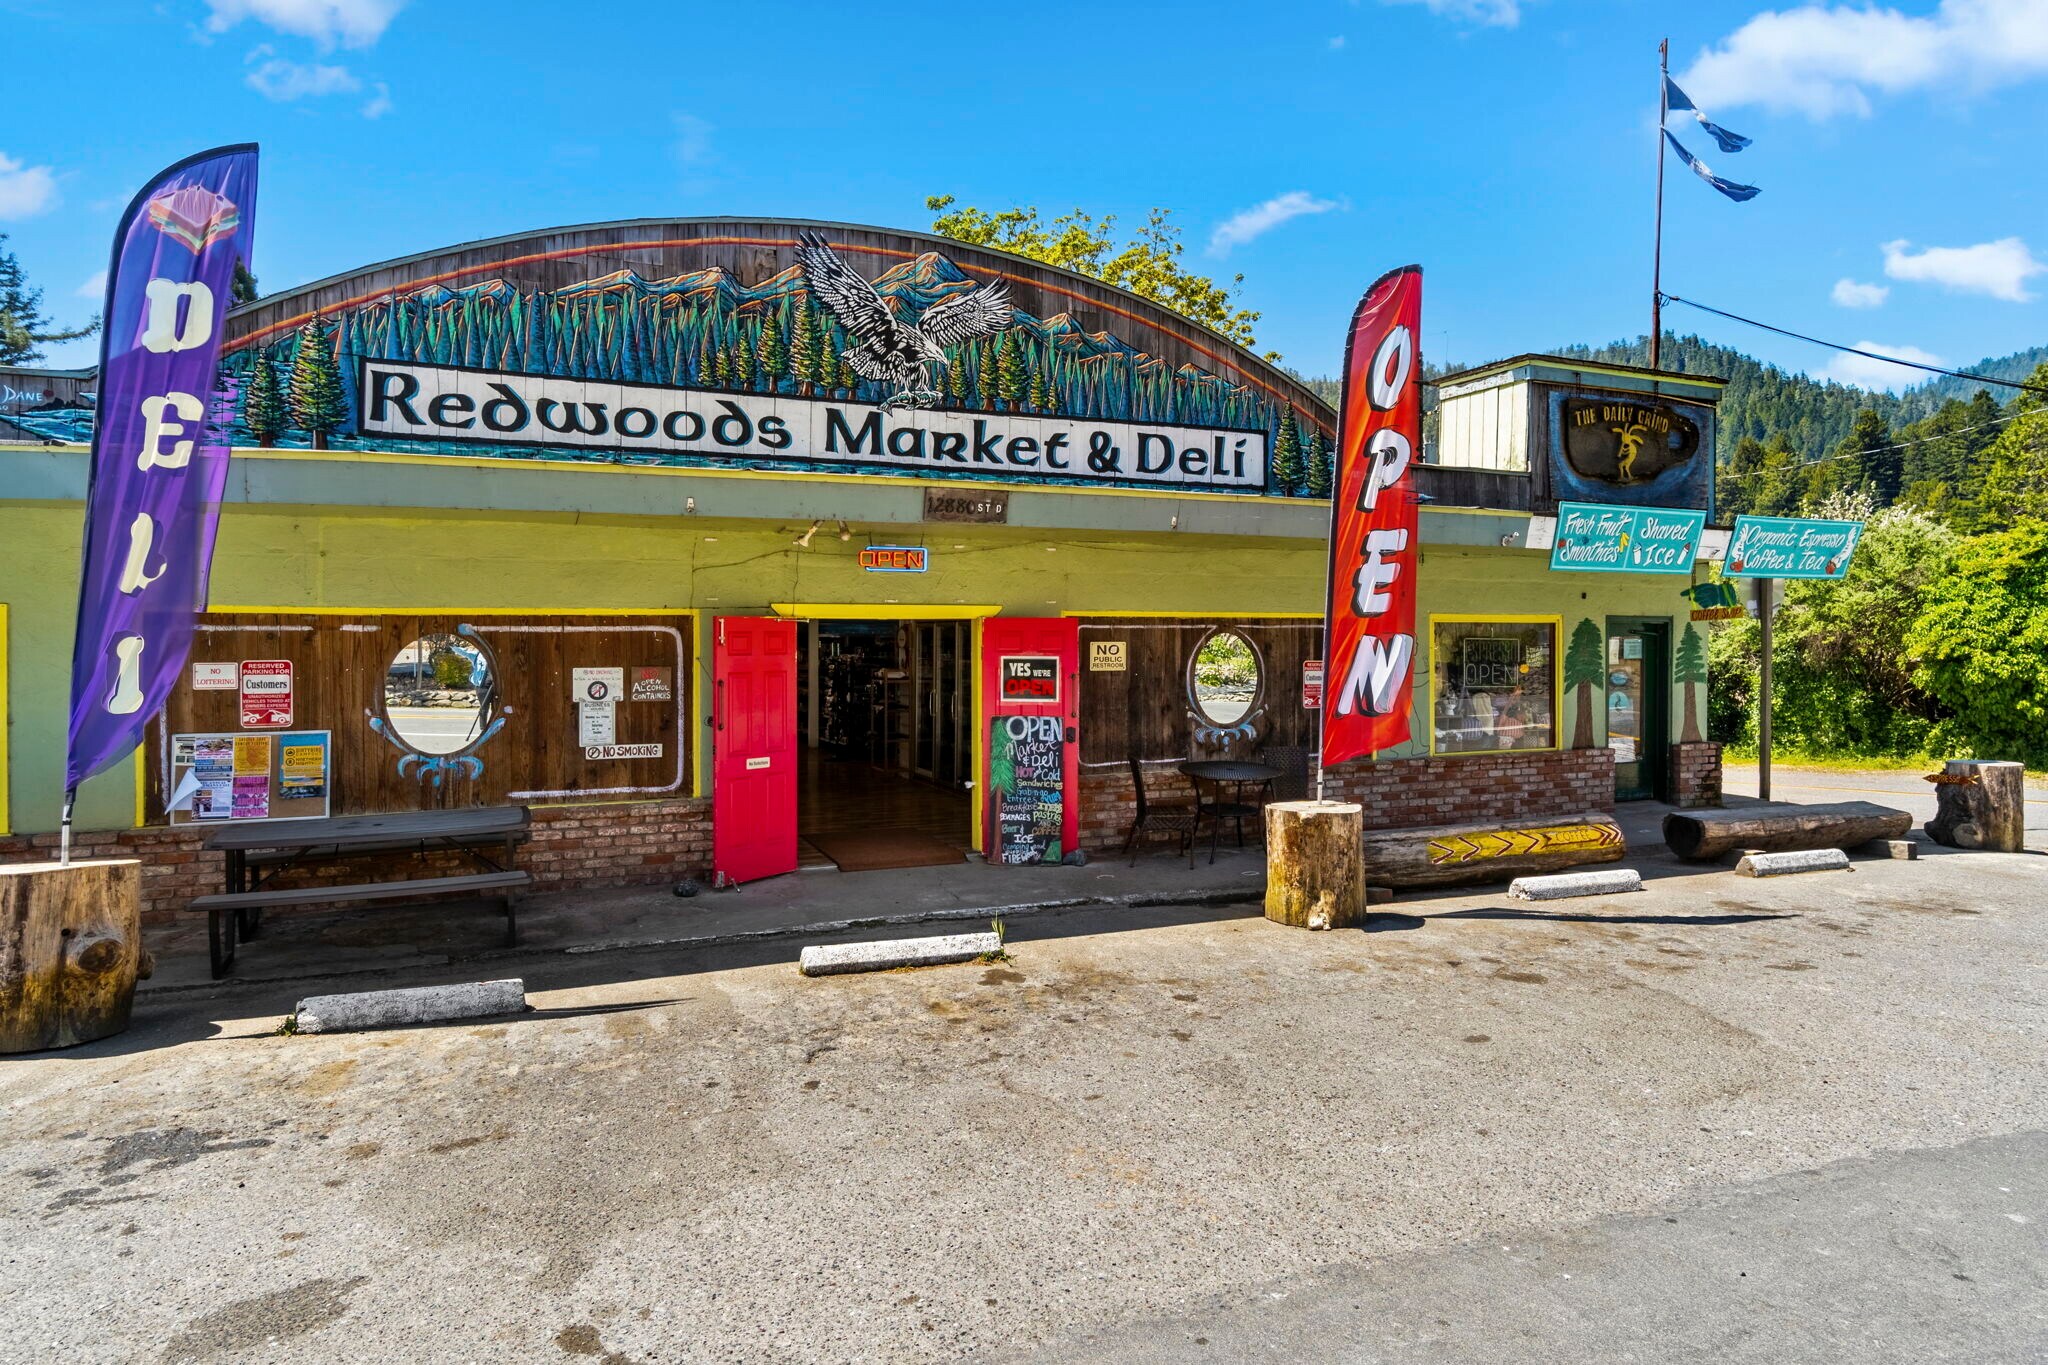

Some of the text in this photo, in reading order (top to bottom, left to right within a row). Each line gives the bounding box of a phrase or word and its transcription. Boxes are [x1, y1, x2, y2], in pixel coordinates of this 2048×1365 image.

[370, 369, 1247, 478] Redwoods Market & Deli
[1575, 403, 1669, 433] THE DAILY GRIND
[116, 277, 212, 716] DELI
[1333, 323, 1415, 717] OPEN
[1565, 511, 1632, 537] Fresh Fruit
[1641, 517, 1695, 541] Shaved
[1745, 525, 1847, 549] Organic Espresso
[858, 550, 923, 568] OPEN
[1560, 538, 1620, 562] Smoothies
[1643, 543, 1675, 567] Ice
[1743, 546, 1826, 570] Coffee & Tea
[1096, 644, 1120, 655] NO
[1009, 662, 1052, 677] YES WE'RE
[1465, 663, 1517, 685] OPEN
[245, 679, 288, 690] Customers
[632, 682, 671, 693] ALCOHOL
[640, 678, 662, 686] OPEN
[1005, 678, 1055, 696] OPEN
[1006, 715, 1063, 743] OPEN
[602, 745, 659, 758] NO SMOKING
[1002, 738, 1059, 760] Market
[1031, 750, 1060, 768] Deli
[1015, 766, 1035, 778] HOT
[1041, 768, 1060, 781] Cold
[999, 812, 1031, 822] BEVERAGES
[1013, 834, 1034, 843] ICE
[1031, 826, 1061, 836] COFFEE
